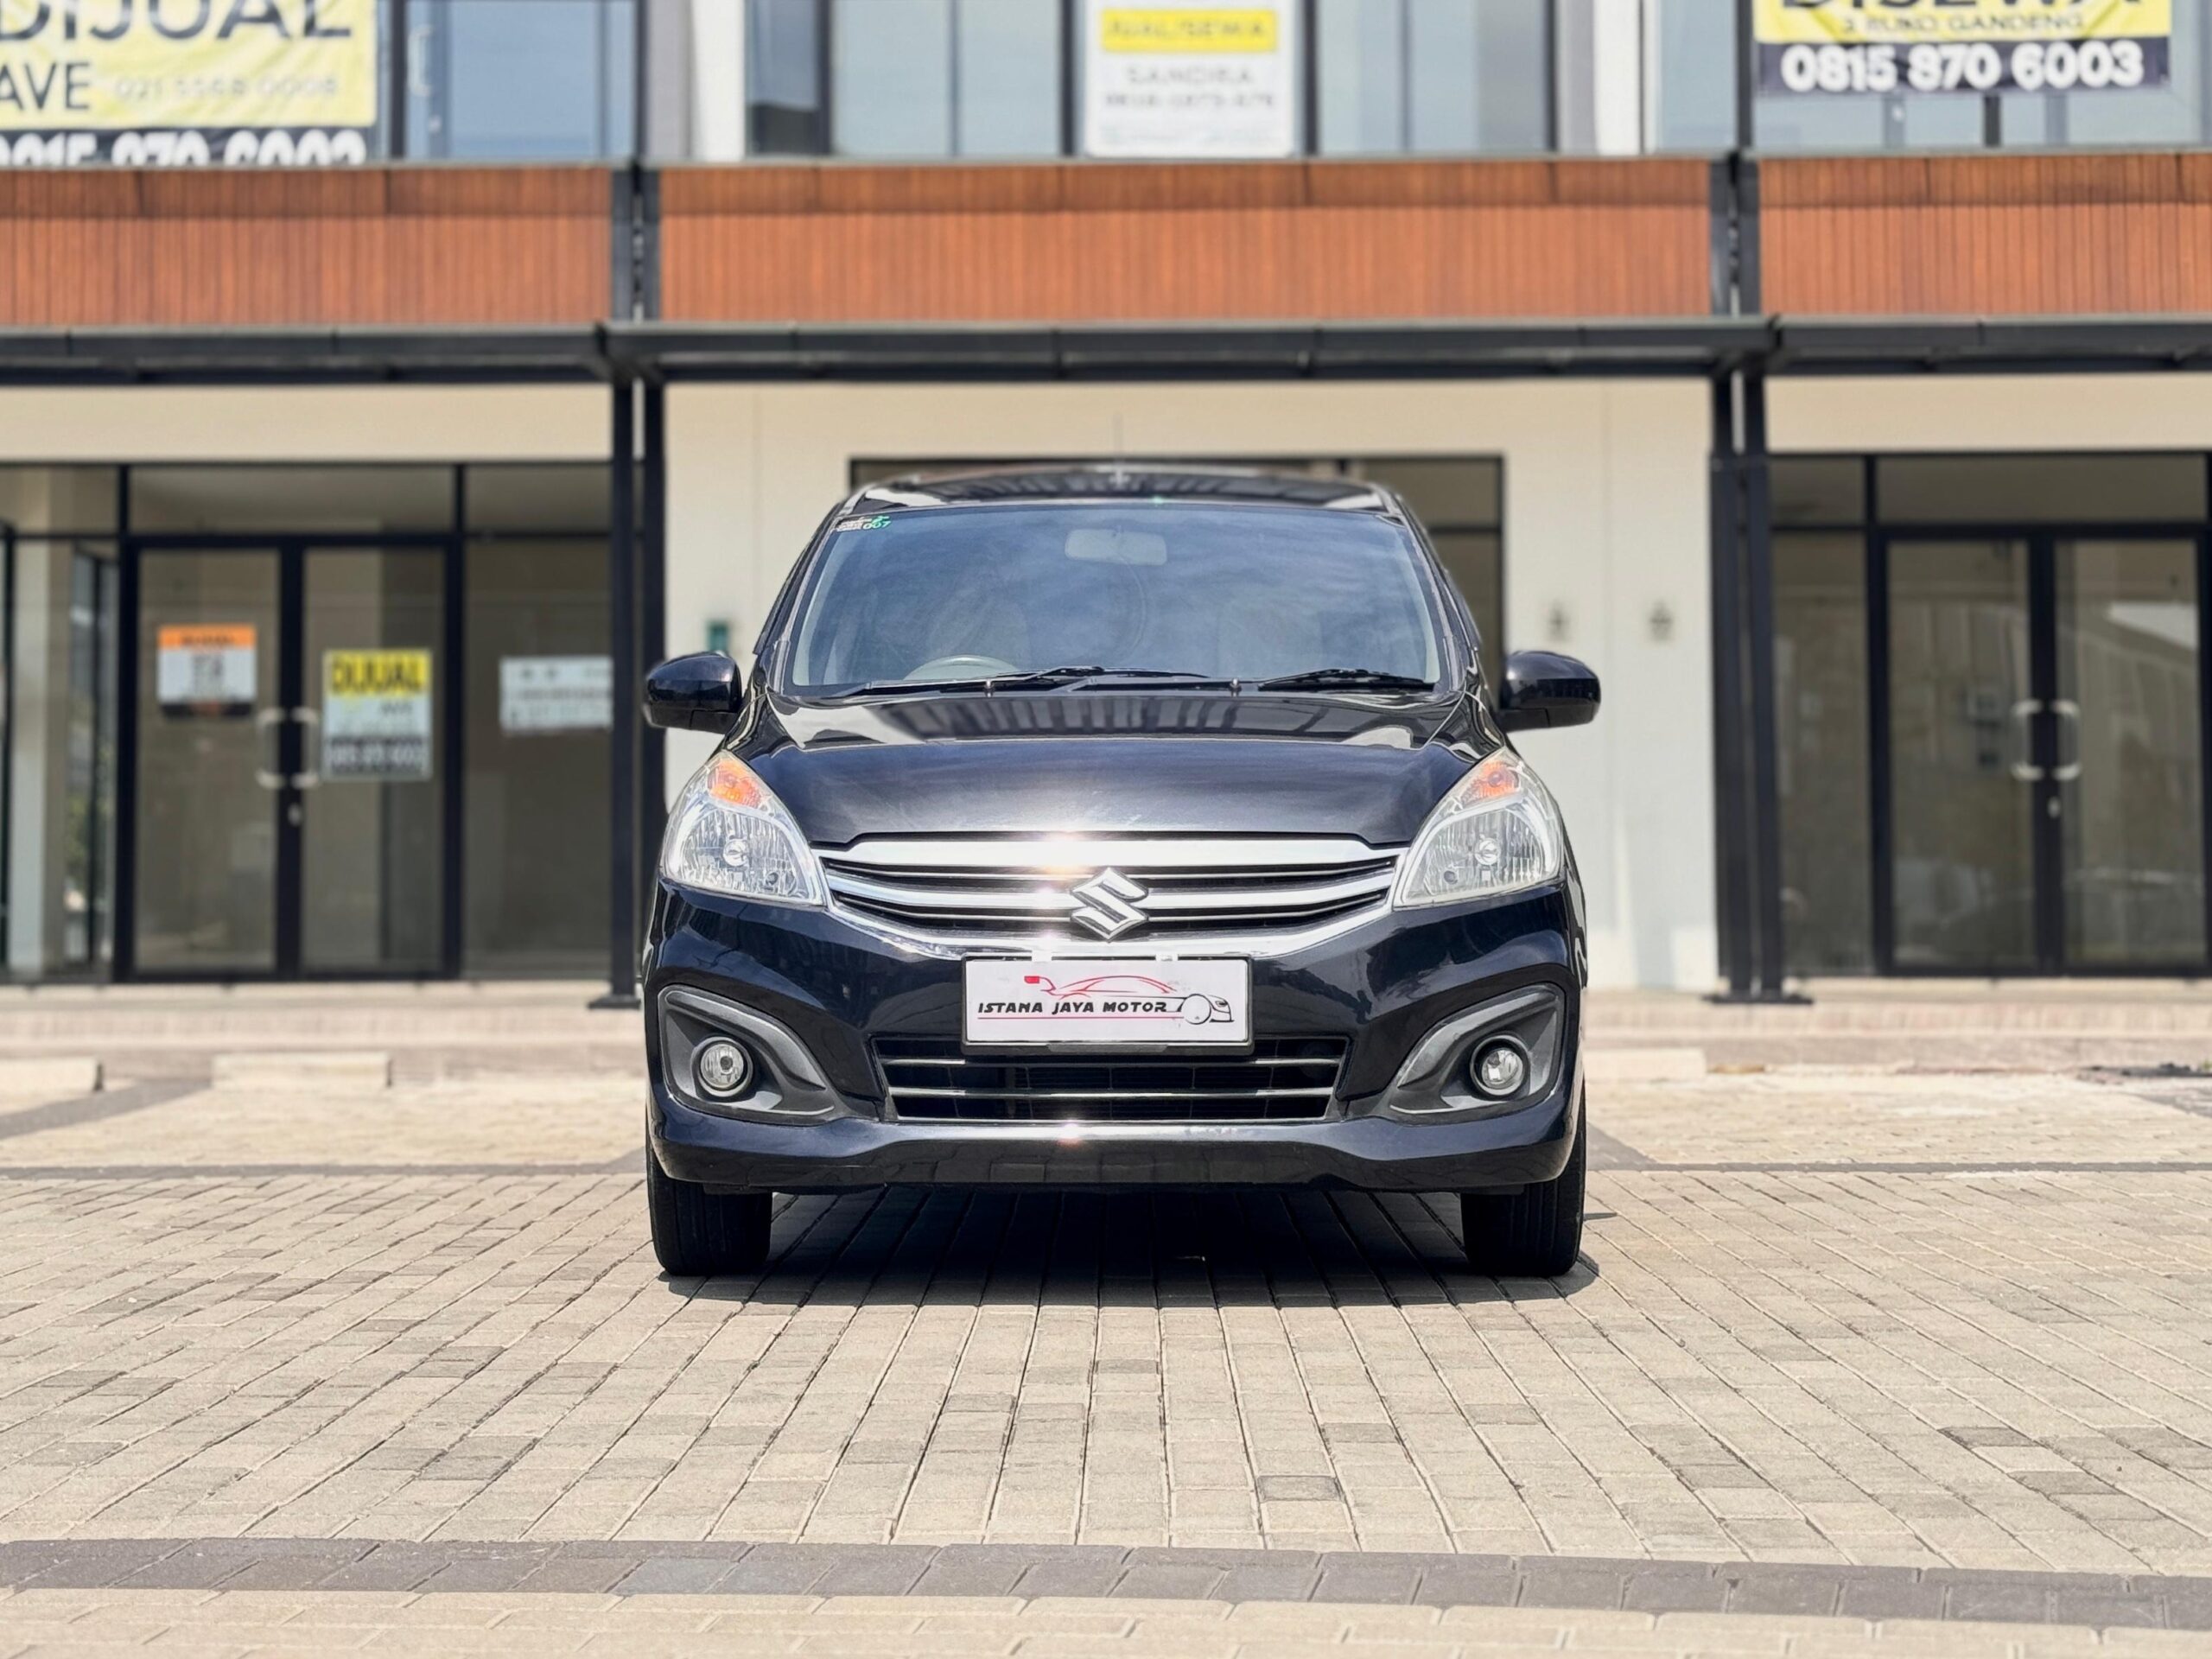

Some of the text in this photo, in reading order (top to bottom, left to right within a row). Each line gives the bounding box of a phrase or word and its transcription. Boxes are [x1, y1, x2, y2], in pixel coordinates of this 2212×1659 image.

[1780, 40, 2145, 92] 0815 870 6003
[977, 1001, 1167, 1016] ISTANA JAYA MOTOR
